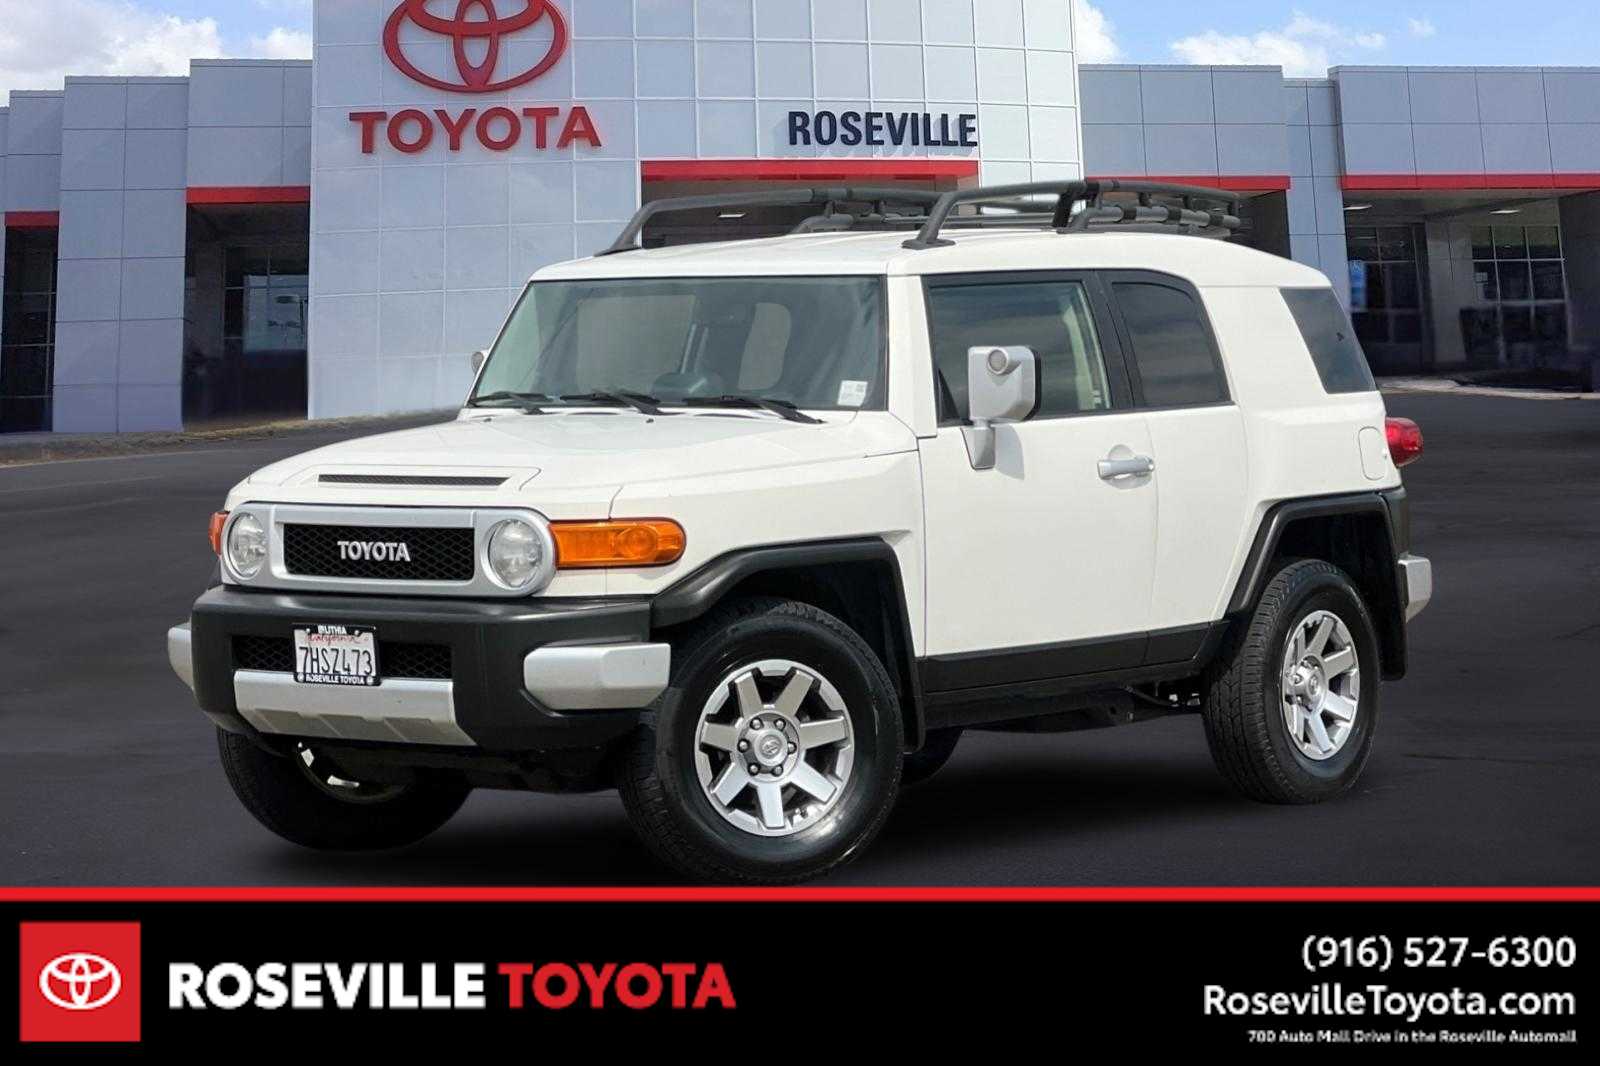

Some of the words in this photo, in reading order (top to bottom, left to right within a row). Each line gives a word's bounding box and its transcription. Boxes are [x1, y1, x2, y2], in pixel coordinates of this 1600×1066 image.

[348, 106, 602, 154] TOYOTA
[788, 110, 978, 147] ROSEVILLE
[337, 540, 411, 562] TOYOTA
[299, 646, 373, 676] 7HSZ473
[305, 673, 340, 684] ROSEVILLE
[340, 675, 365, 685] TOYOTA
